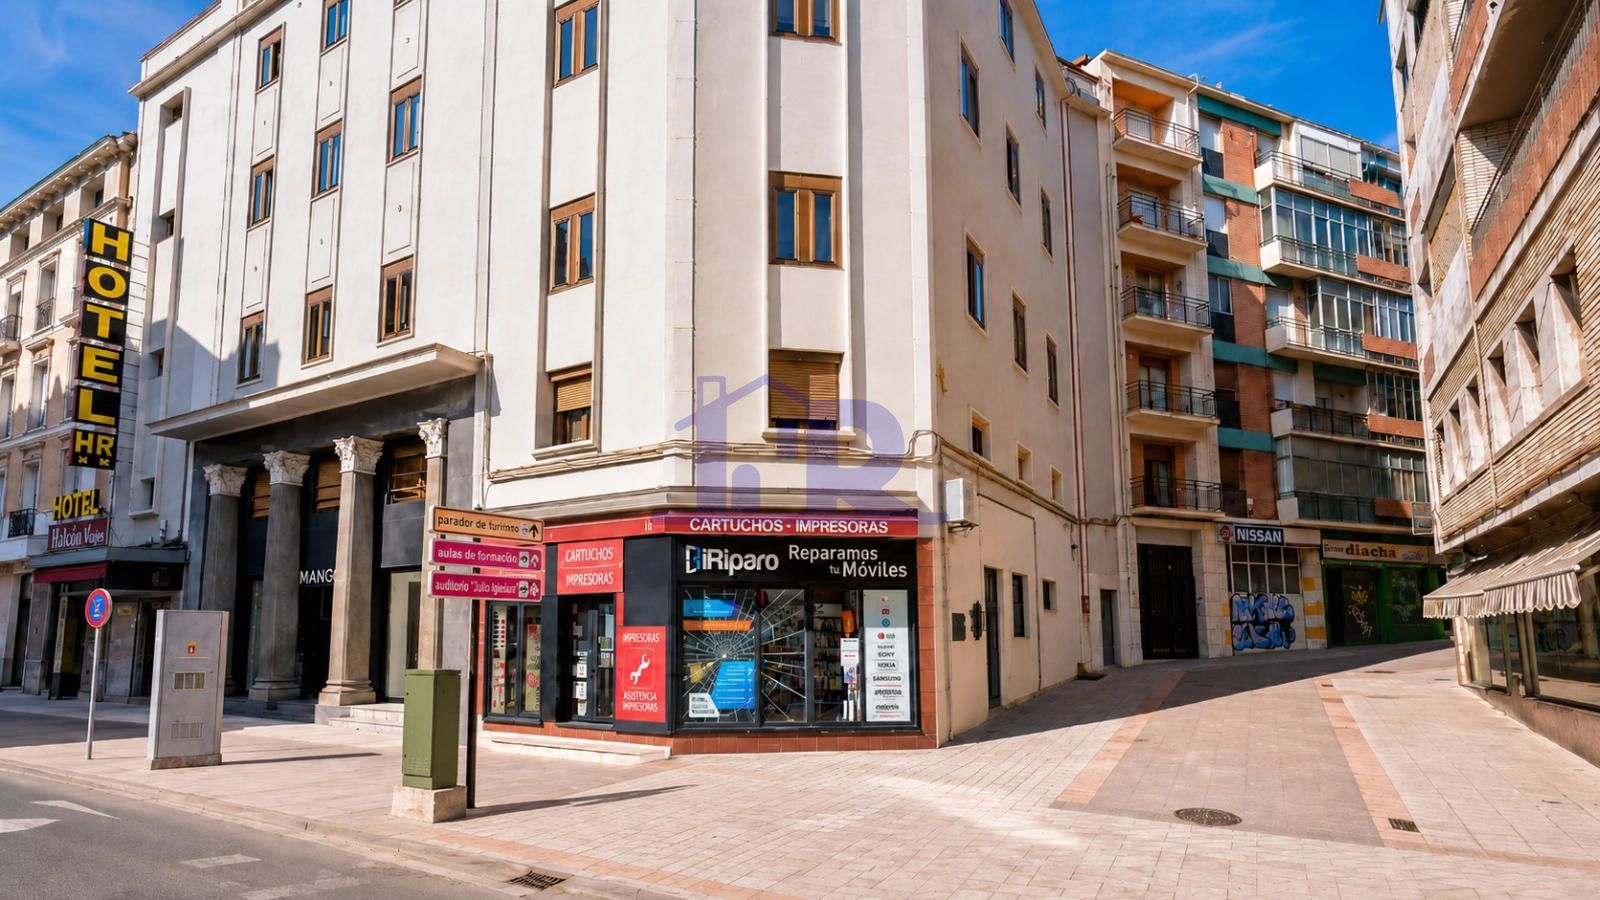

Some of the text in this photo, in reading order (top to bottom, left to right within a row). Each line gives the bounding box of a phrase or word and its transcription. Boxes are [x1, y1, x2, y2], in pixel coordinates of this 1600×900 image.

[77, 222, 130, 426] HOTEL
[52, 488, 99, 521] HOTEL
[437, 515, 473, 528] parador
[475, 519, 487, 529] de
[689, 517, 889, 534] CARTUCHOS IMPRESORAS
[51, 525, 82, 549] Halcón
[1236, 528, 1282, 543] NISSAN
[437, 548, 463, 559] aulas
[464, 550, 476, 560] de
[565, 546, 614, 562] CARTUCHOS
[788, 544, 878, 563] Reparamos
[1345, 543, 1397, 558] diacha
[702, 548, 780, 577] iRiparo
[842, 560, 908, 578] Móviles
[565, 571, 614, 587] IMPRESORAS
[623, 632, 660, 644] IMPRESORAS
[622, 701, 658, 713] IMPRESORAS
